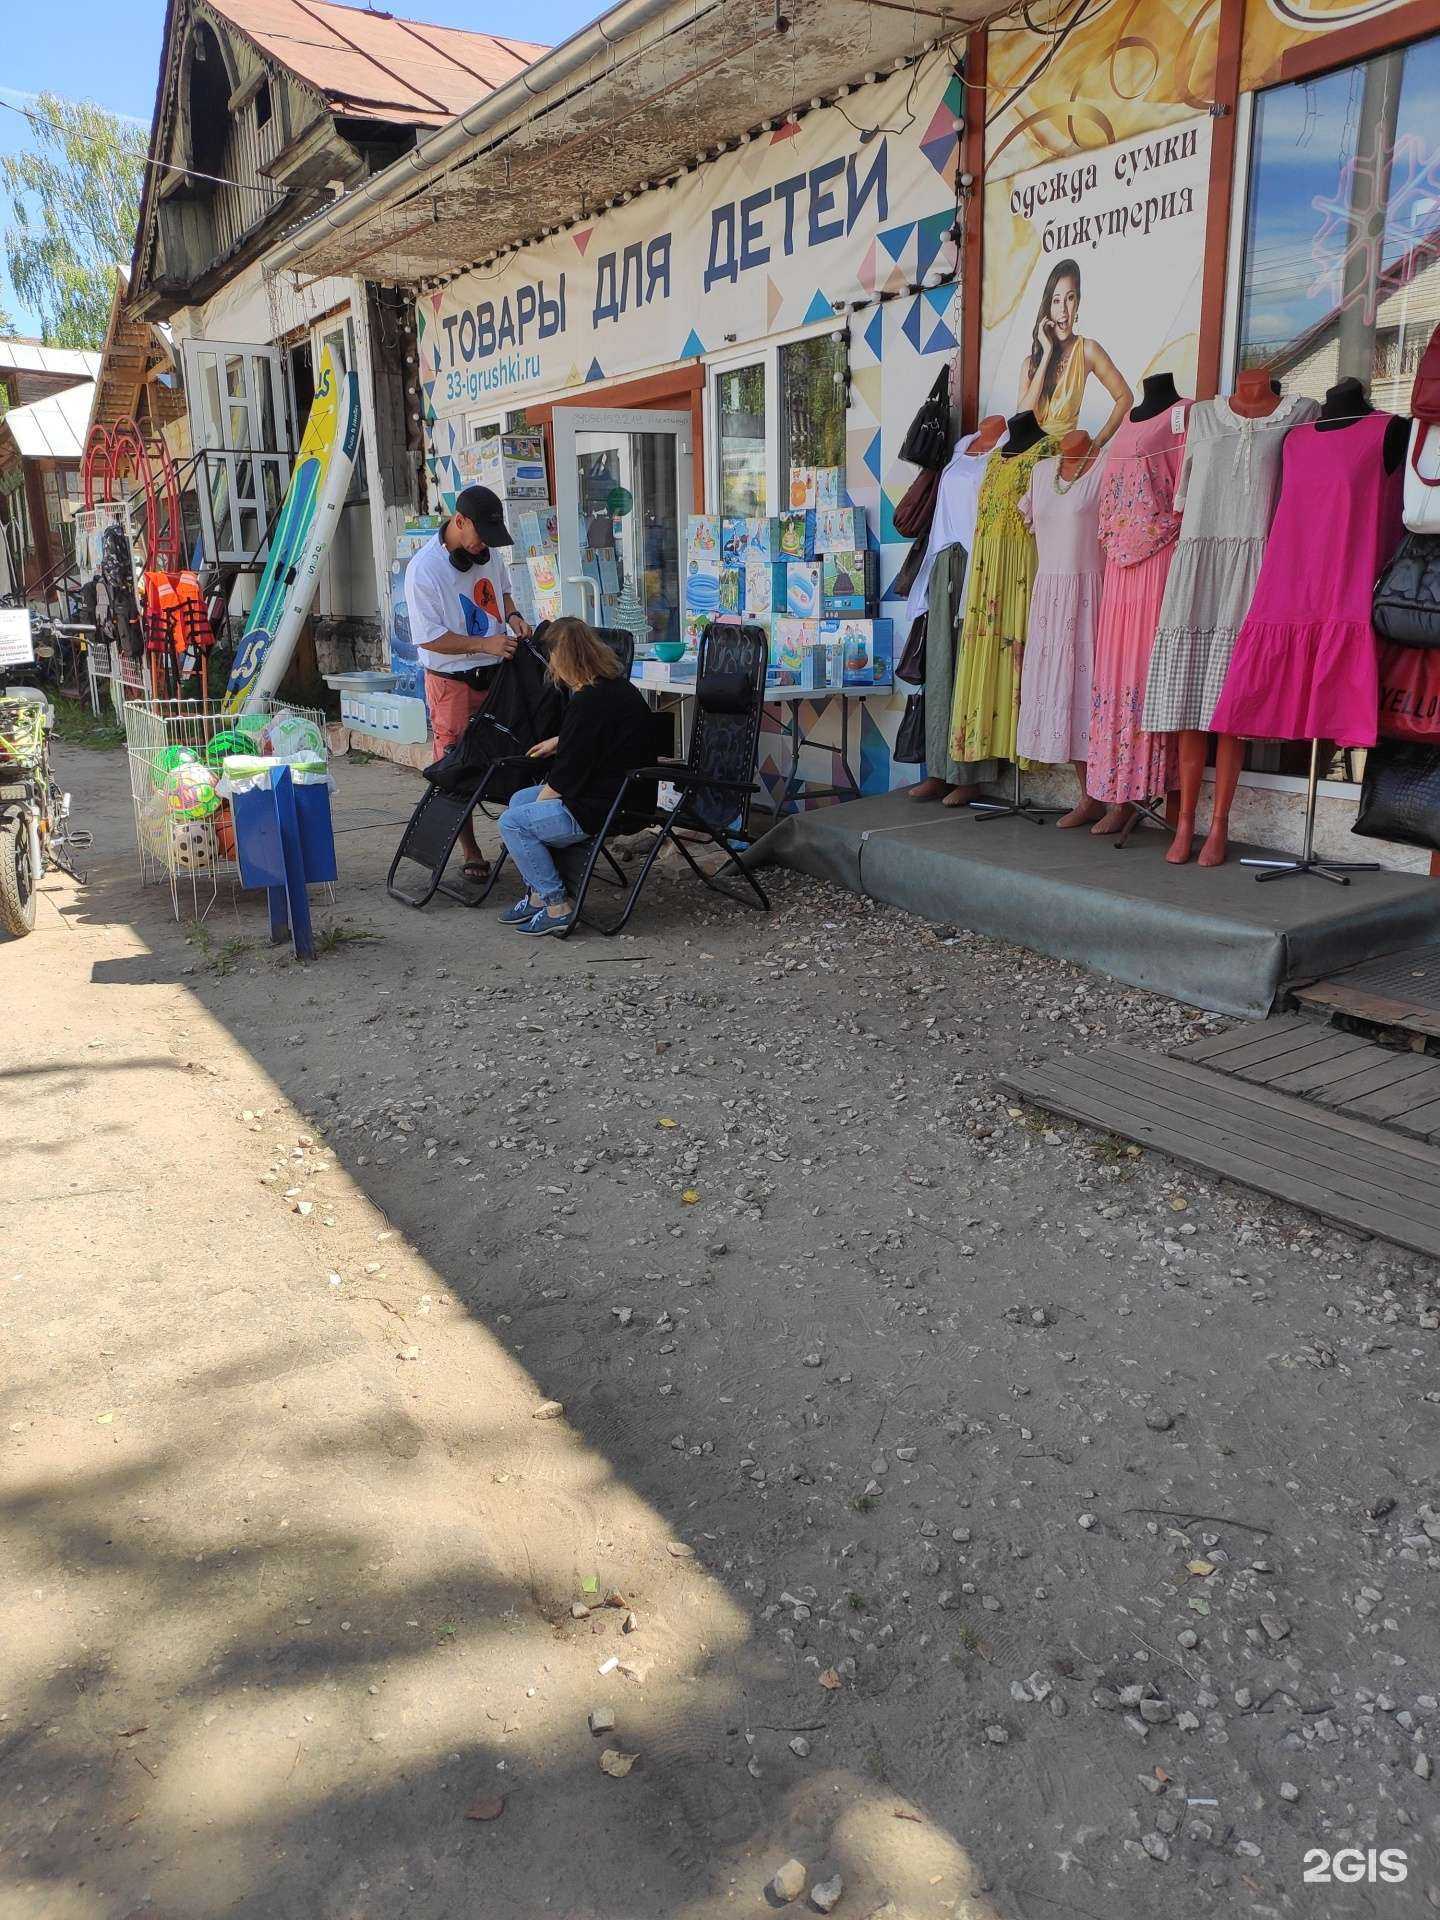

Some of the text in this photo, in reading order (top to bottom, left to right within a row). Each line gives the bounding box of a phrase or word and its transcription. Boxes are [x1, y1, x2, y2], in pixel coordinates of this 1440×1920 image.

[1010, 128, 1198, 219] одежда сумки
[442, 124, 890, 368] ТОВАРЫ ДЛЯ ДЕТЕЙ
[1042, 186, 1194, 253] бижутерия
[446, 352, 541, 401] 33-igrushki.ru
[1380, 687, 1440, 718] YELLO
